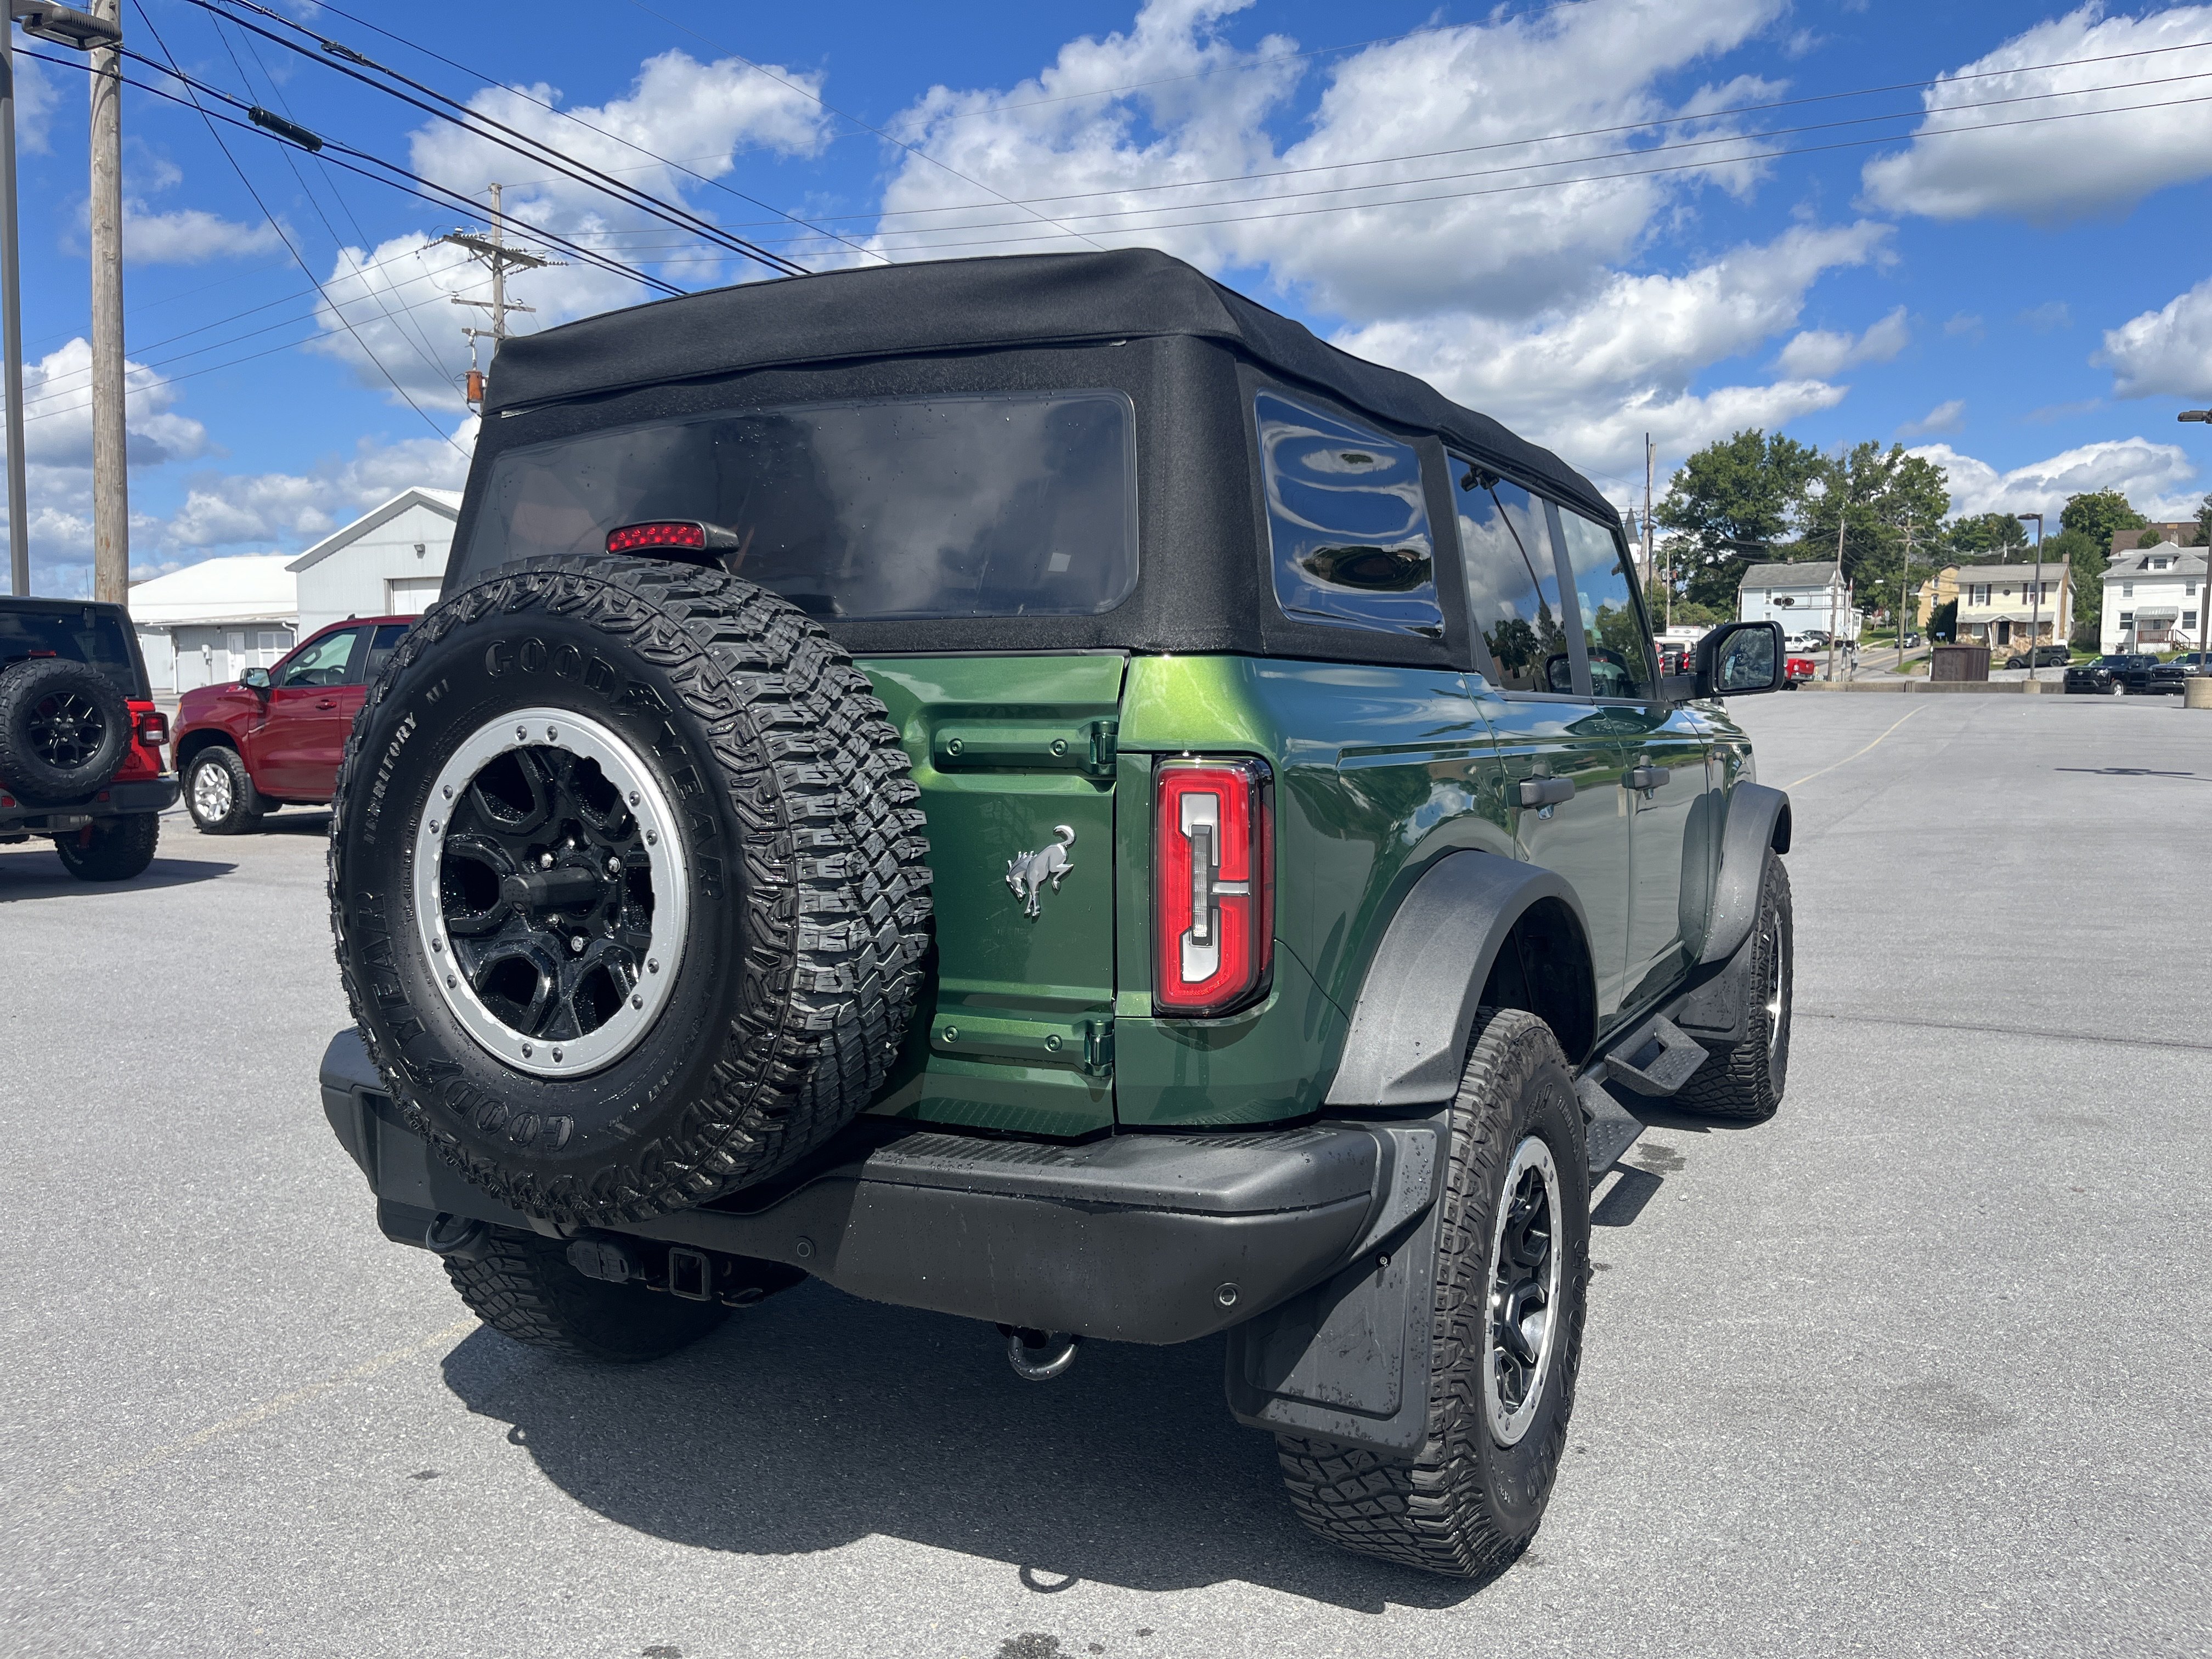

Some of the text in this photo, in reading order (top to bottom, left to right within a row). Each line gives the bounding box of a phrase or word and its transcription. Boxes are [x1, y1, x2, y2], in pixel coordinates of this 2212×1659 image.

[363, 712, 418, 845] TERRITORY
[484, 637, 725, 901] GOODYEAR
[354, 890, 574, 1153] GOODYEAR
